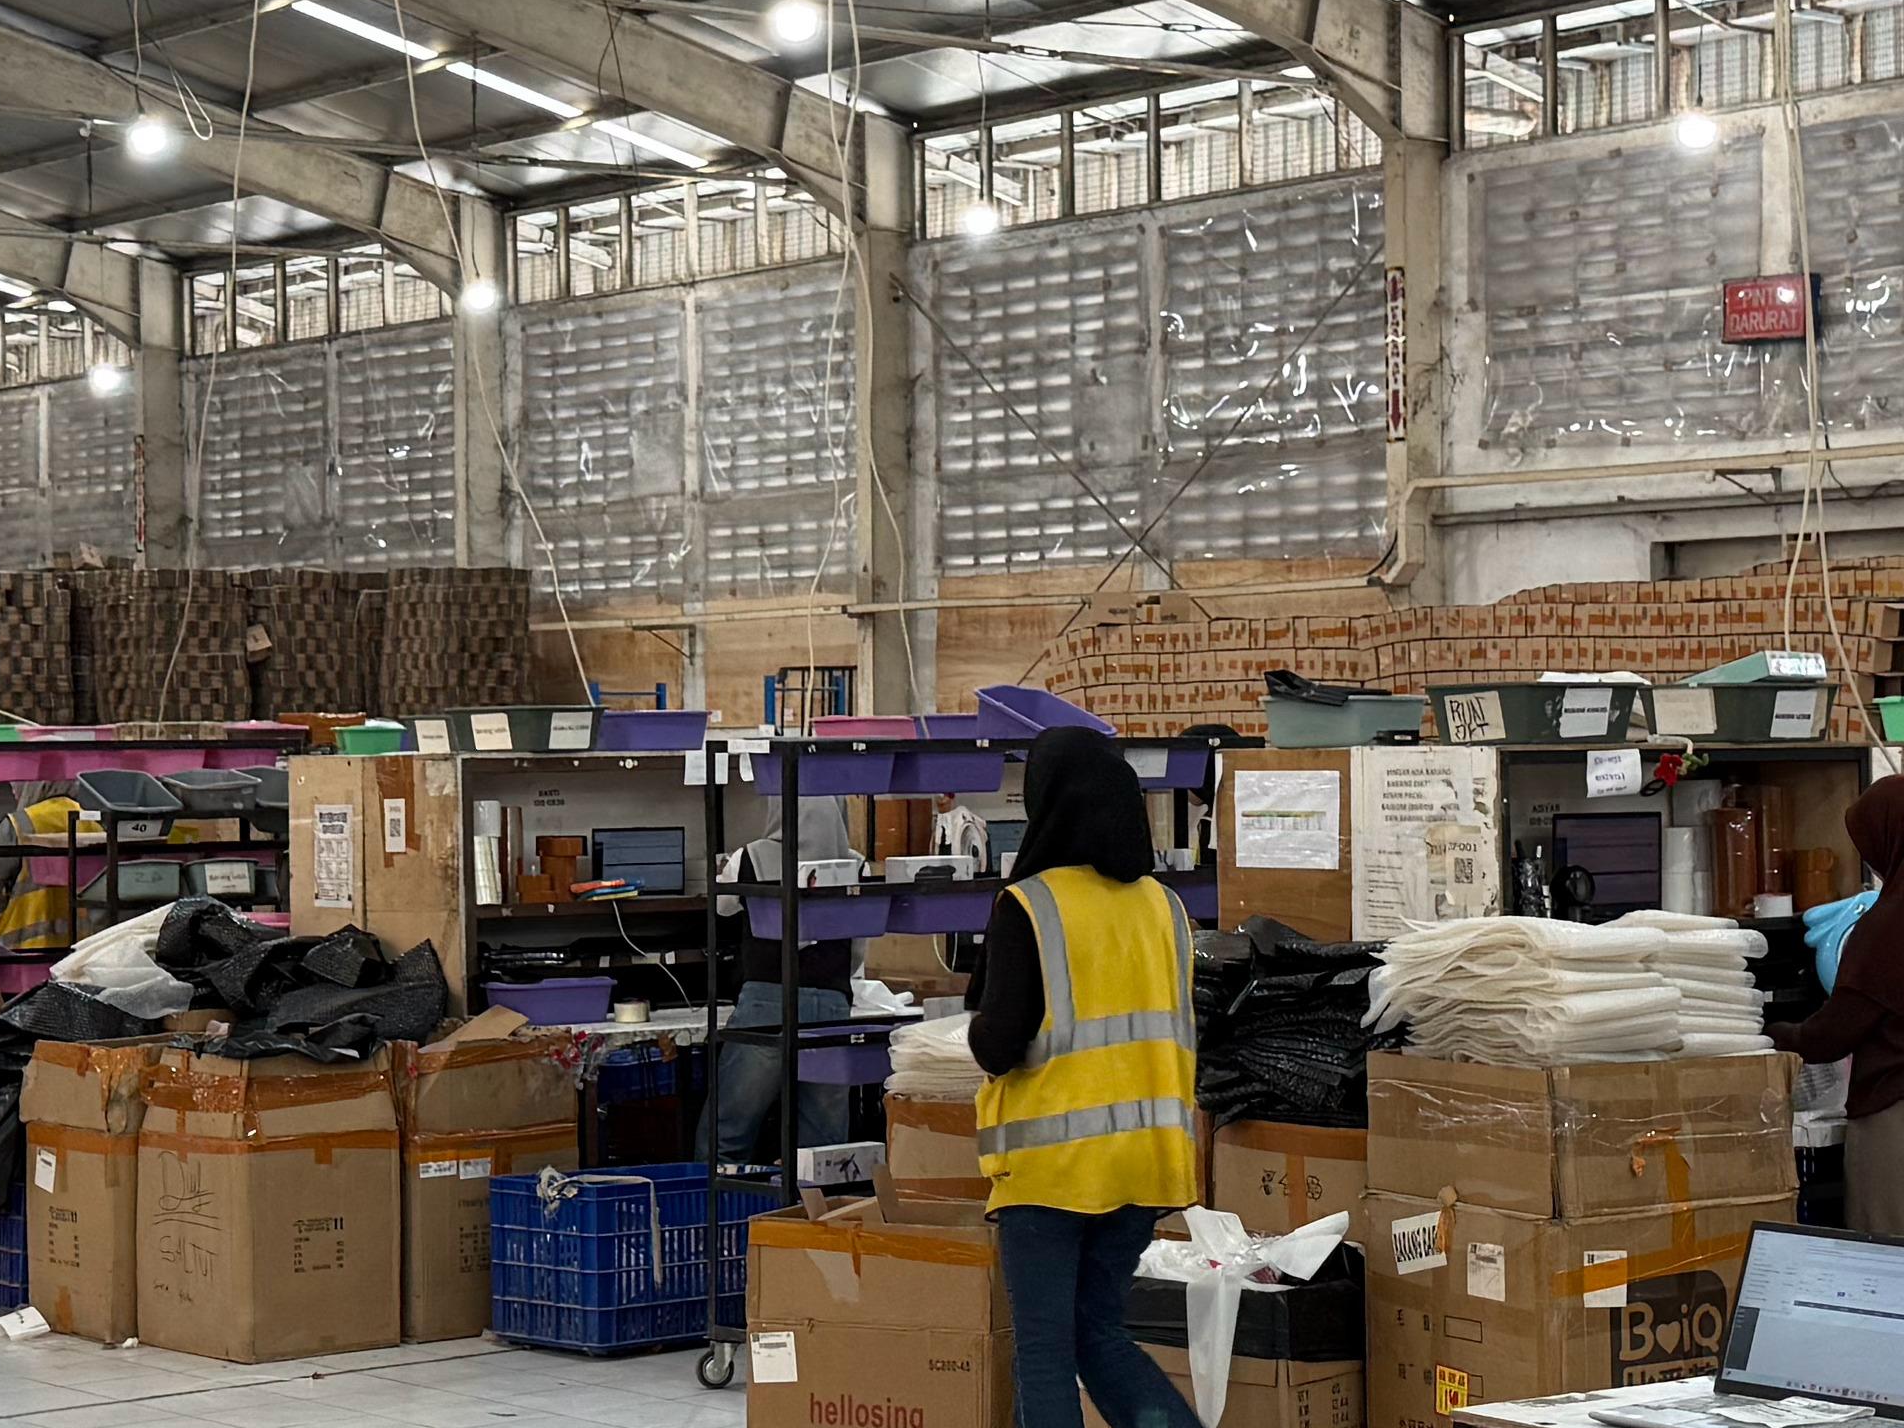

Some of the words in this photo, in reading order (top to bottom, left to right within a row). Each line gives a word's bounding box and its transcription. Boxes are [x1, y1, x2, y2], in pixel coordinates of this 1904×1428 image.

[1742, 285, 1797, 309] PINT
[1730, 310, 1798, 332] DARURAT
[131, 822, 147, 833] 40
